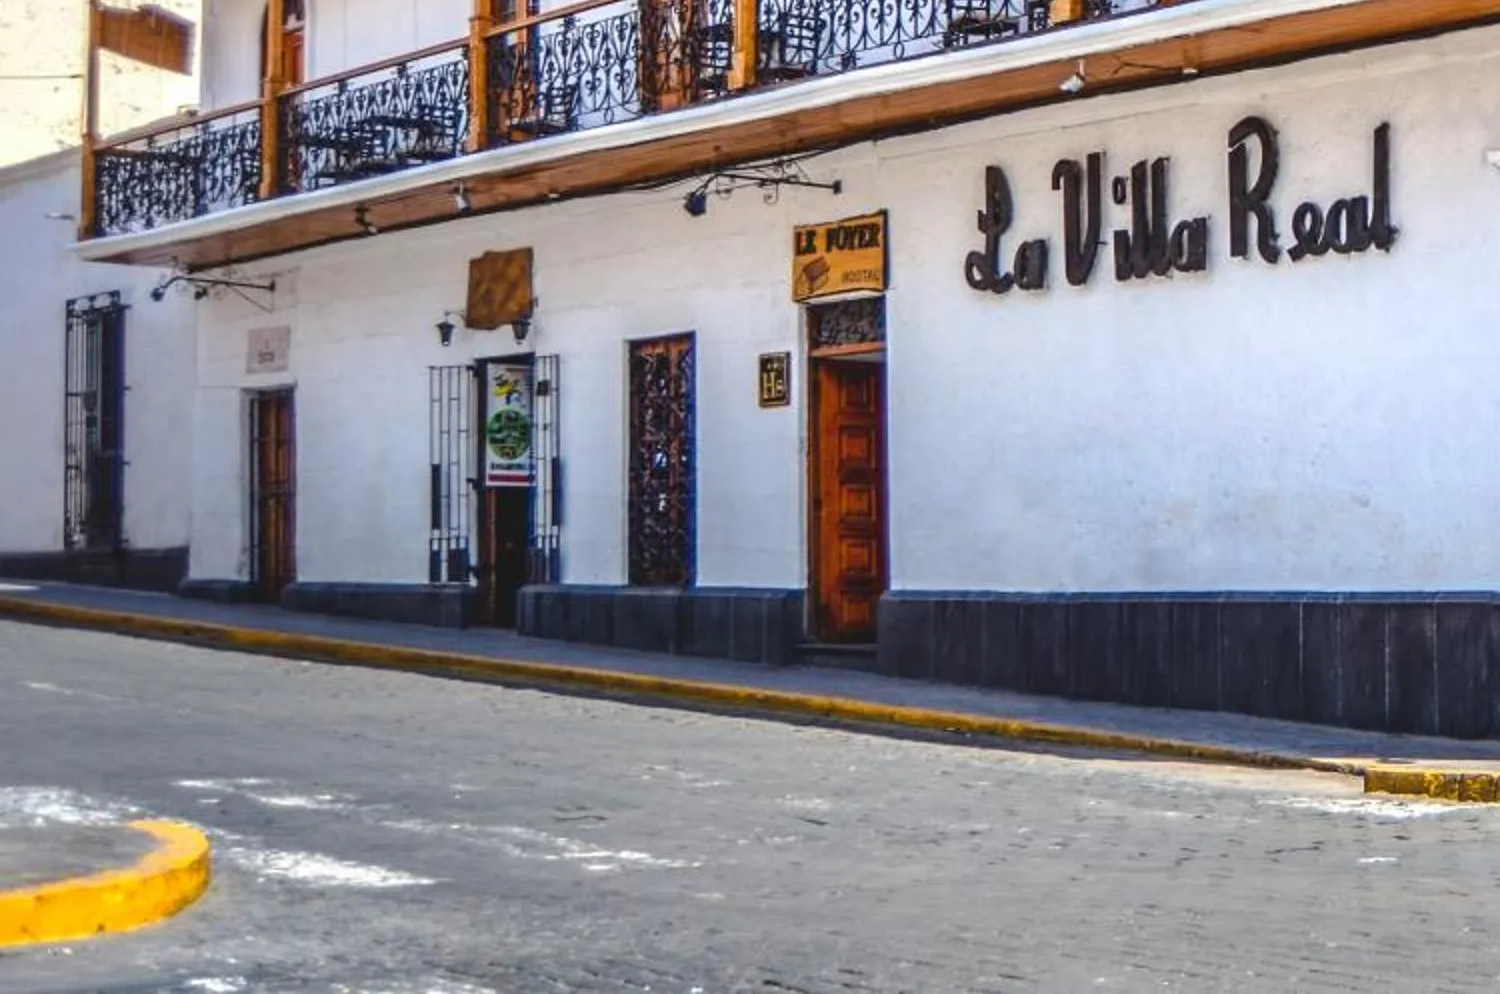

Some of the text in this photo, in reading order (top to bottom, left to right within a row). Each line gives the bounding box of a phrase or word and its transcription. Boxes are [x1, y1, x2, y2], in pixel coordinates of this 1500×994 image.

[795, 223, 880, 255] LE FOYER
[964, 115, 1397, 294] La Villa Real
